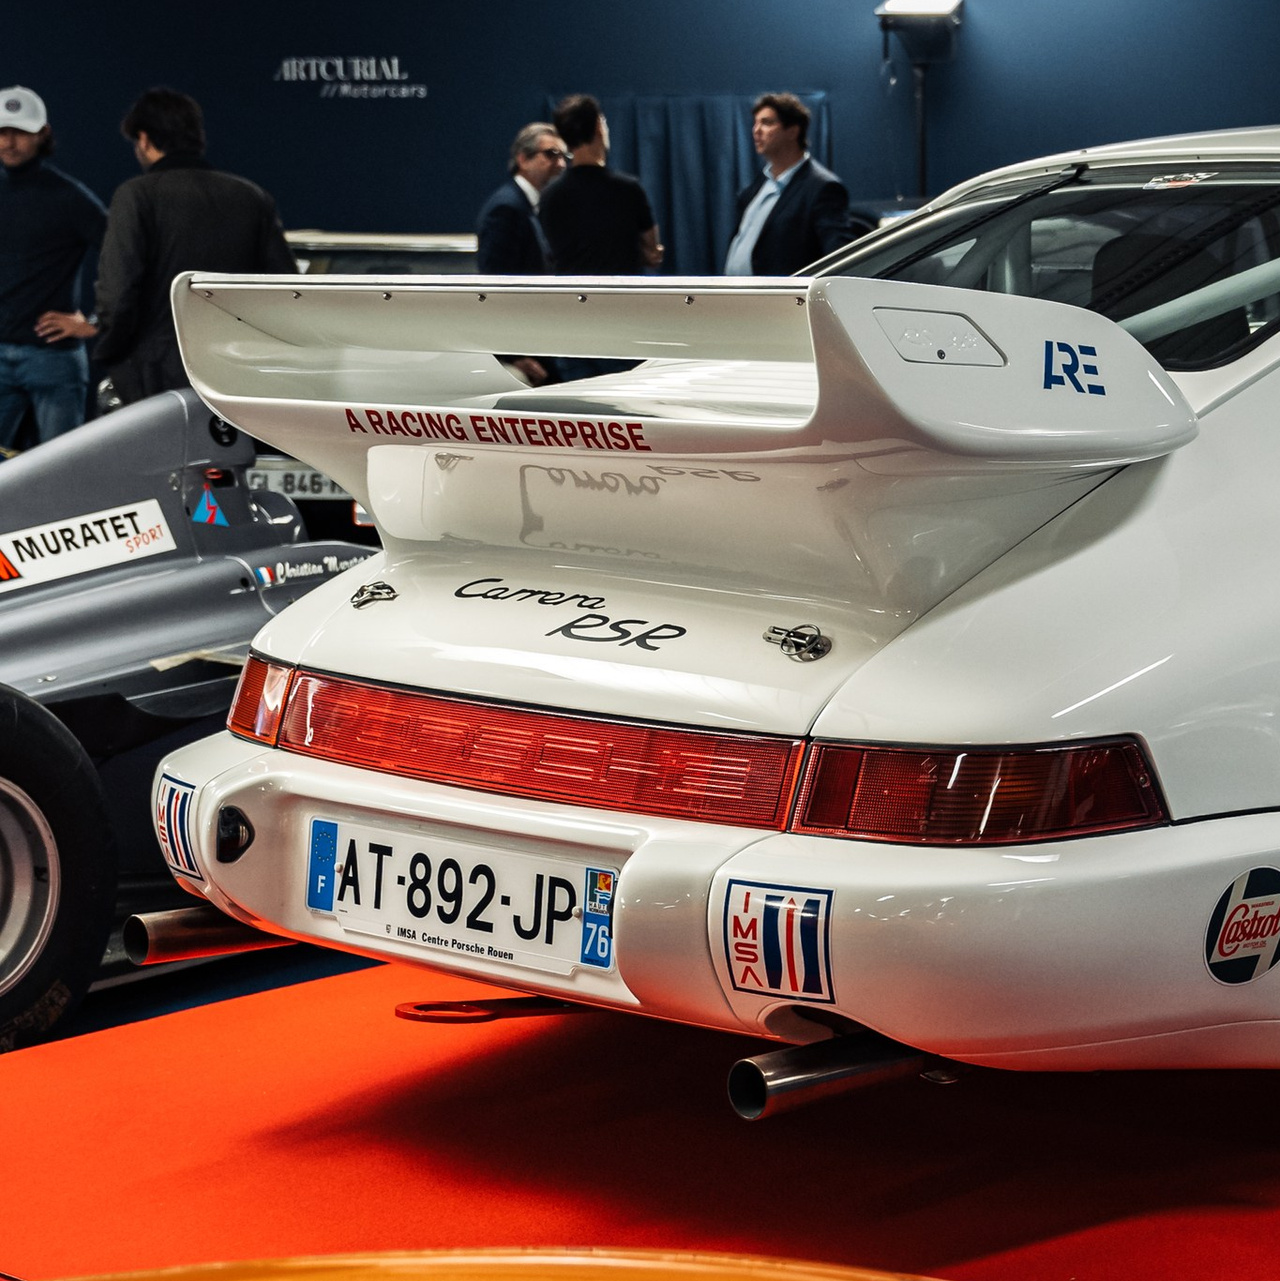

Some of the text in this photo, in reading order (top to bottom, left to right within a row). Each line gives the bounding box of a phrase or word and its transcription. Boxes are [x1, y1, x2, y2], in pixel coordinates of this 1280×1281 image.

[273, 56, 408, 81] ARTCURIAL
[1043, 340, 1106, 396] ARE
[345, 408, 652, 451] A RACING ENTERPRISE
[12, 511, 141, 563] MURATET
[125, 524, 164, 553] SPORT
[454, 578, 606, 609] Carrera
[544, 613, 687, 651] RSR
[316, 875, 327, 894] F
[337, 838, 577, 945] AT-892-JP
[397, 927, 514, 961] IMSA Centre Porsche Rouen
[584, 922, 609, 958] 76
[733, 891, 764, 988] IMSA
